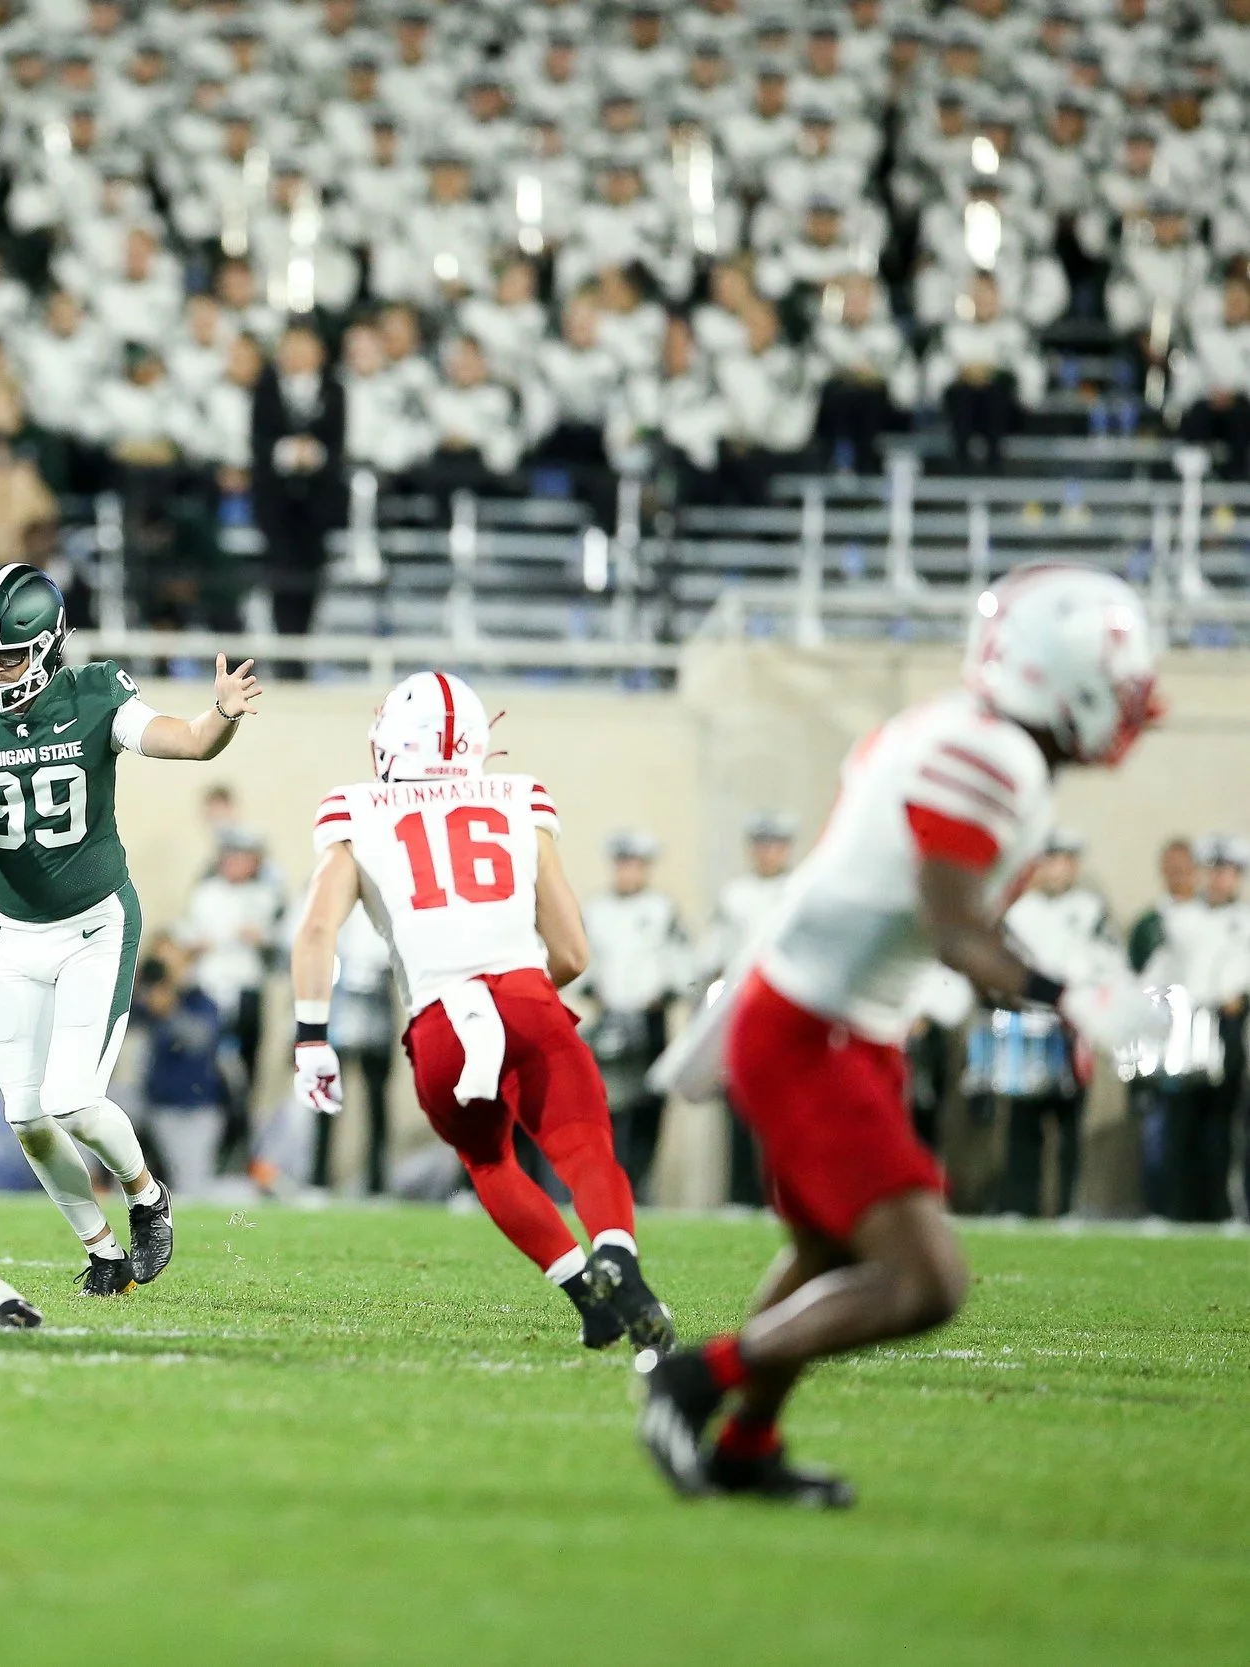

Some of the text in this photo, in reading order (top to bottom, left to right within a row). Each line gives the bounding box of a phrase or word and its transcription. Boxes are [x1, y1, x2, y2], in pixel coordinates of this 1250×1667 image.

[39, 740, 84, 761] STATE
[435, 730, 468, 755] 16
[369, 781, 514, 808] WEINMASTER
[394, 806, 515, 910] 16
